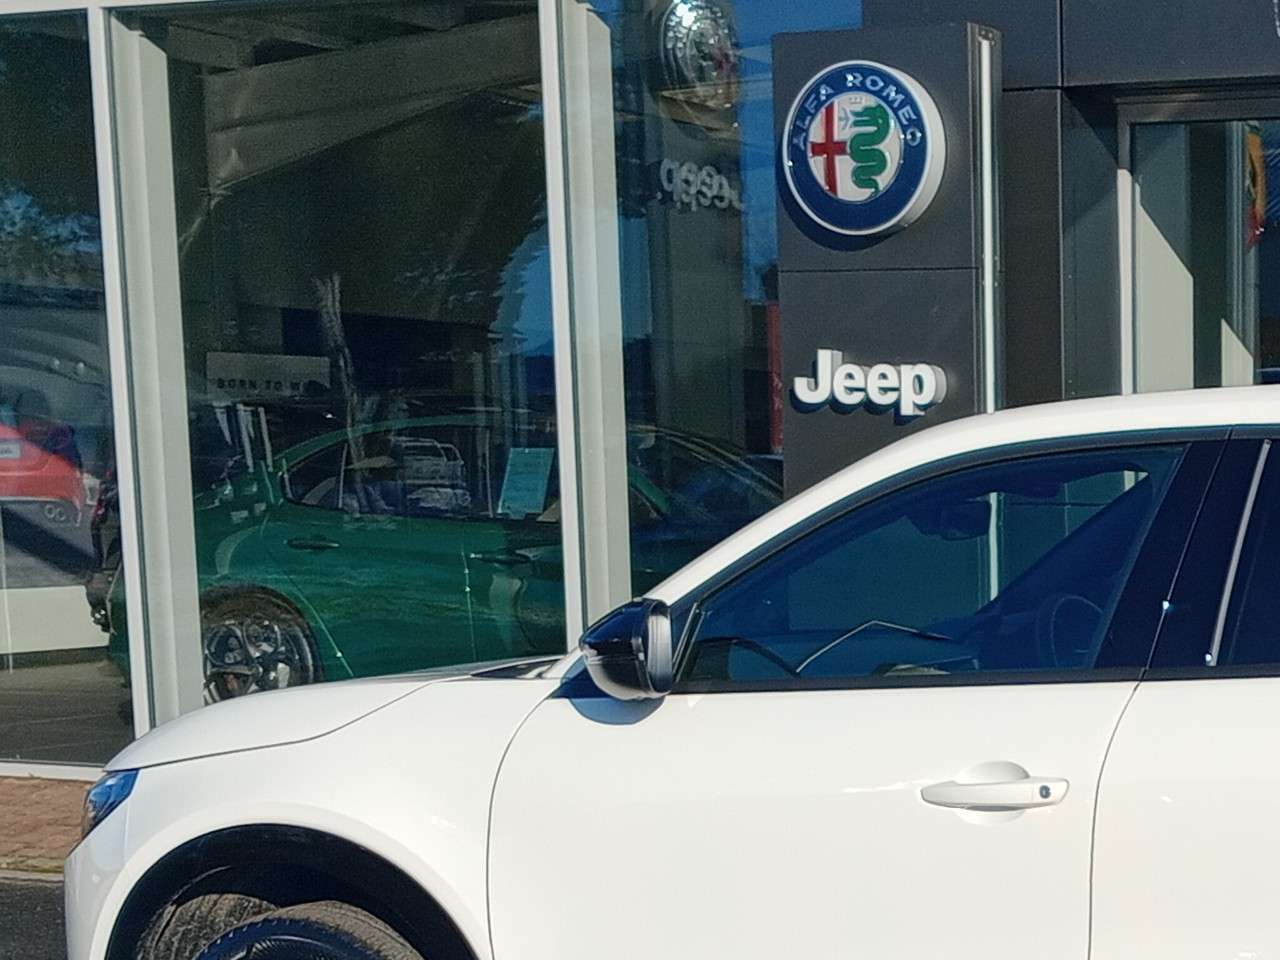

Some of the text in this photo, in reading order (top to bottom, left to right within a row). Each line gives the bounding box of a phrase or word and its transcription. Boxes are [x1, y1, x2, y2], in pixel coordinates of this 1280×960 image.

[792, 72, 922, 150] ALFA ROMEO
[793, 348, 940, 416] Jeep
